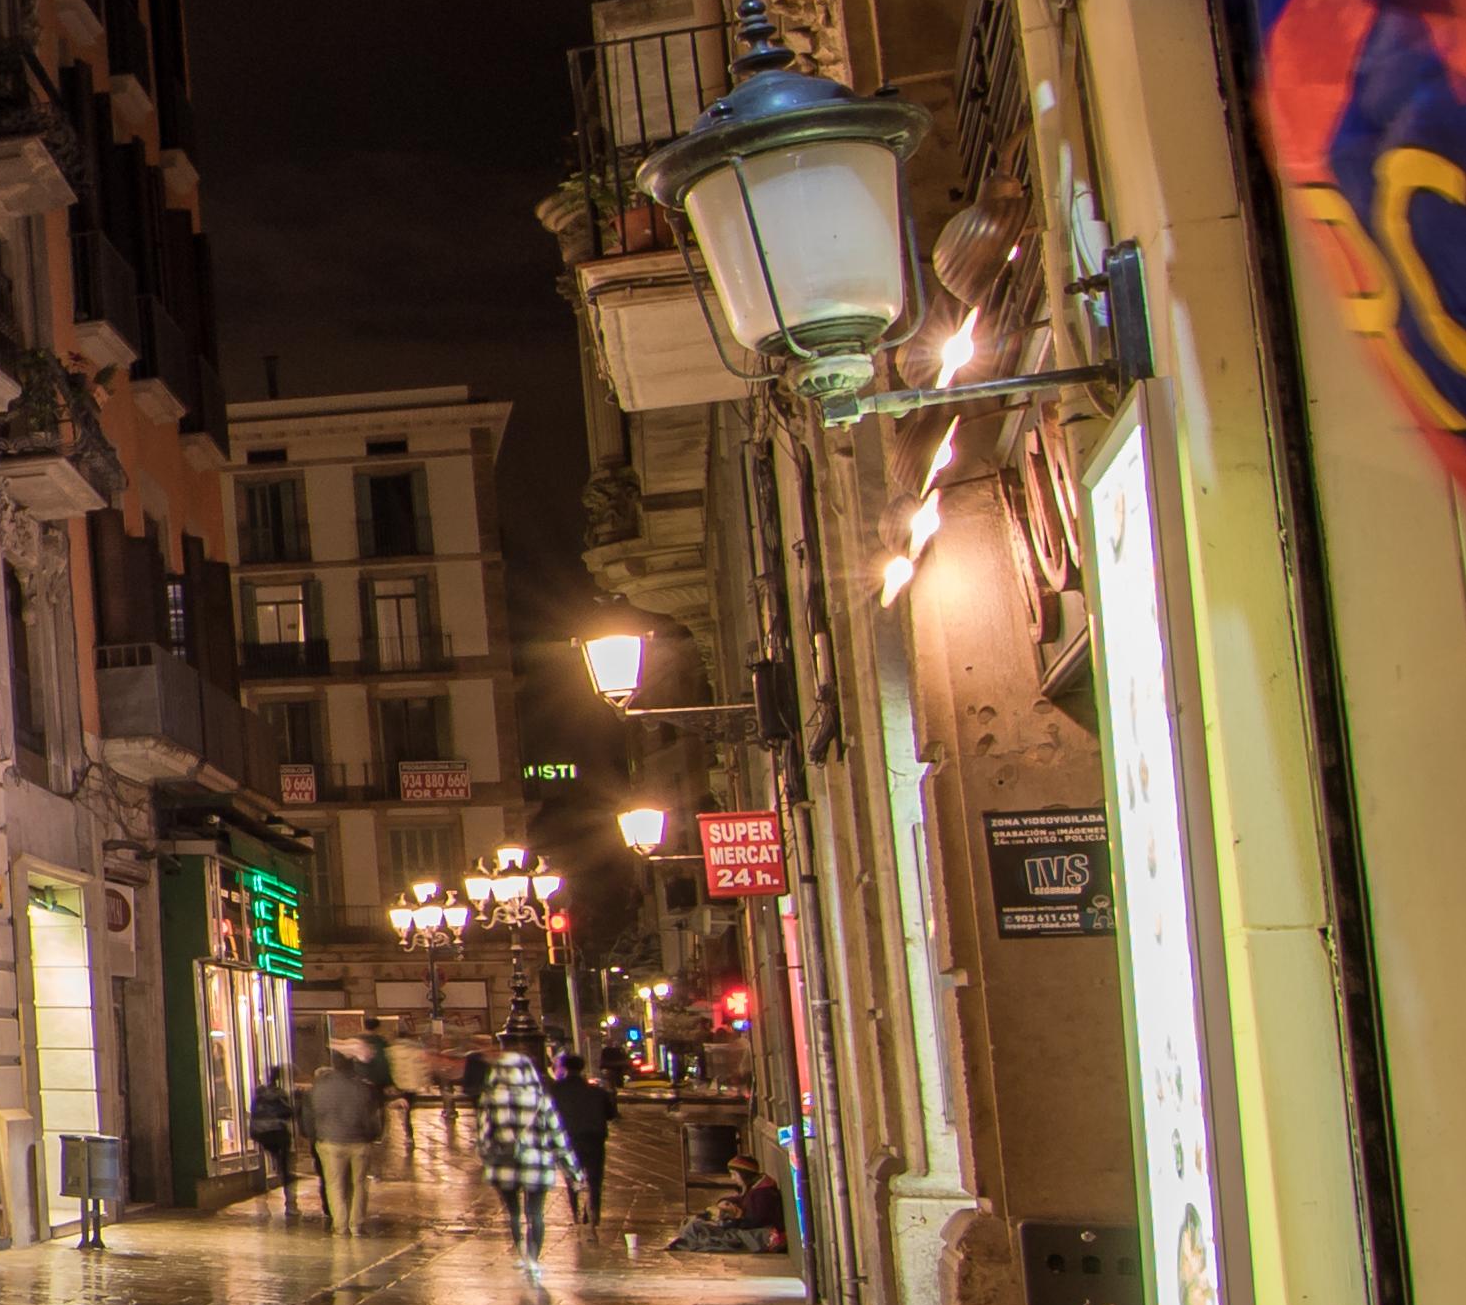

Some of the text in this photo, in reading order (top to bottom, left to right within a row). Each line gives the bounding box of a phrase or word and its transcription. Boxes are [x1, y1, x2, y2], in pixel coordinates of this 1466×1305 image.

[293, 776, 313, 791] 660
[402, 774, 422, 789] 934
[448, 773, 467, 788] 660
[406, 788, 466, 798] FOR SALE
[991, 814, 1105, 827] ZONA VIDEOVIGILADA
[709, 820, 774, 844] SUPER
[1026, 836, 1057, 844] AVISO
[709, 844, 780, 865] MERCAT
[717, 868, 780, 888] 24 h.
[1025, 854, 1089, 893] IVS
[1015, 914, 1034, 922] 902
